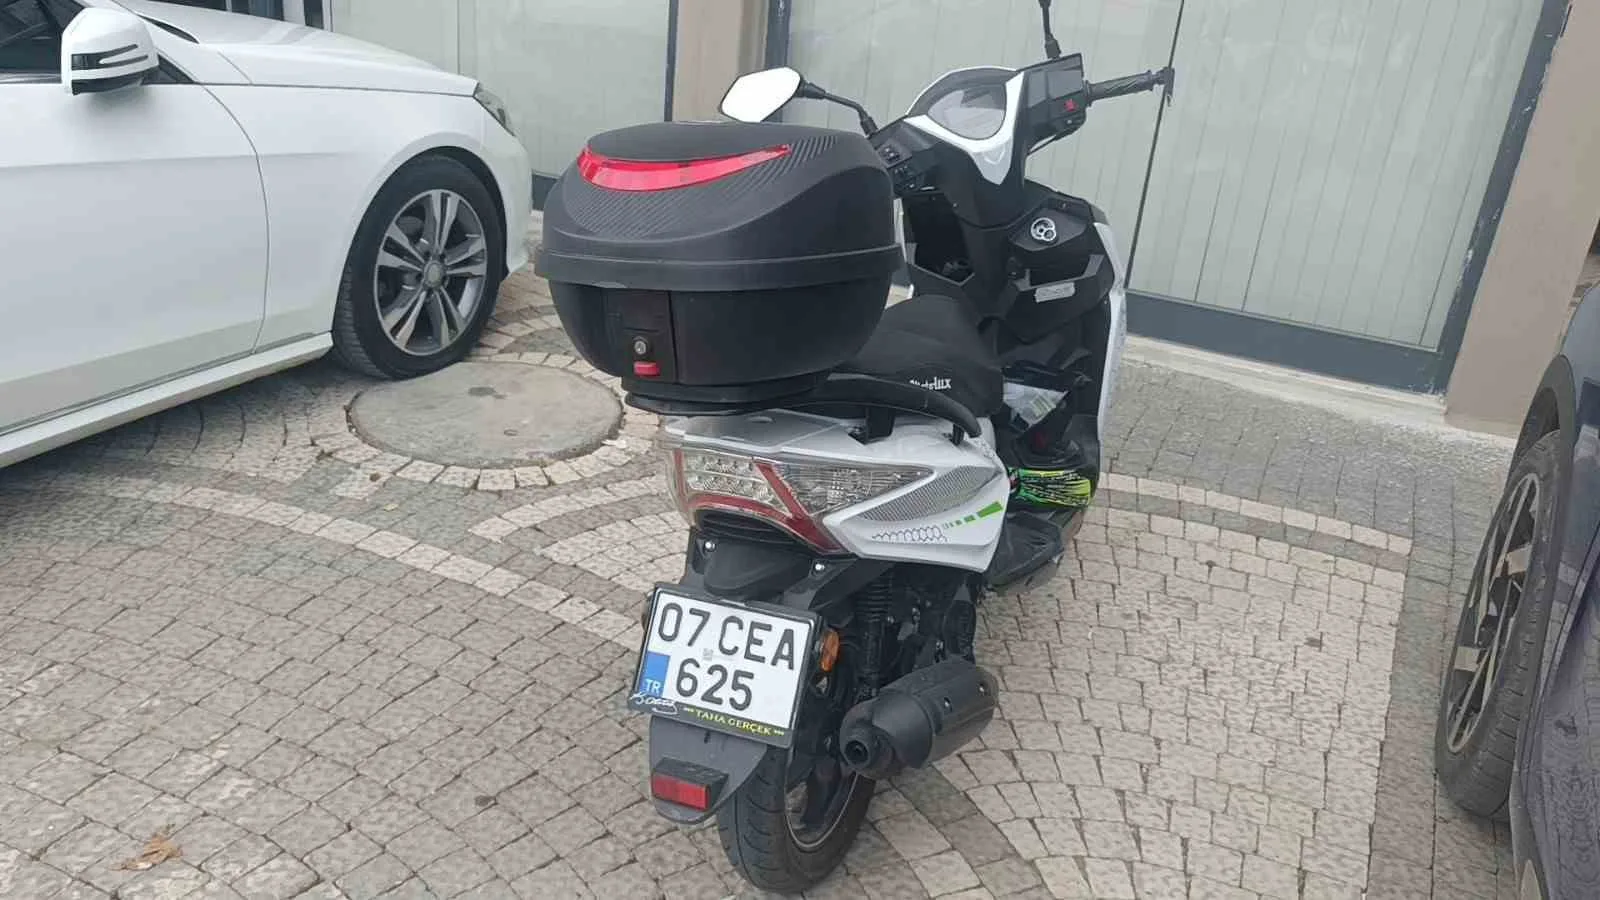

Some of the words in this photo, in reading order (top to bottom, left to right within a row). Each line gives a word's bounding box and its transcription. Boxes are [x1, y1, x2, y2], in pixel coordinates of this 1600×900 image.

[657, 602, 711, 647] 07
[718, 615, 795, 670] CEA
[645, 679, 661, 695] TR
[676, 657, 754, 711] 625
[695, 709, 726, 724] TAHA
